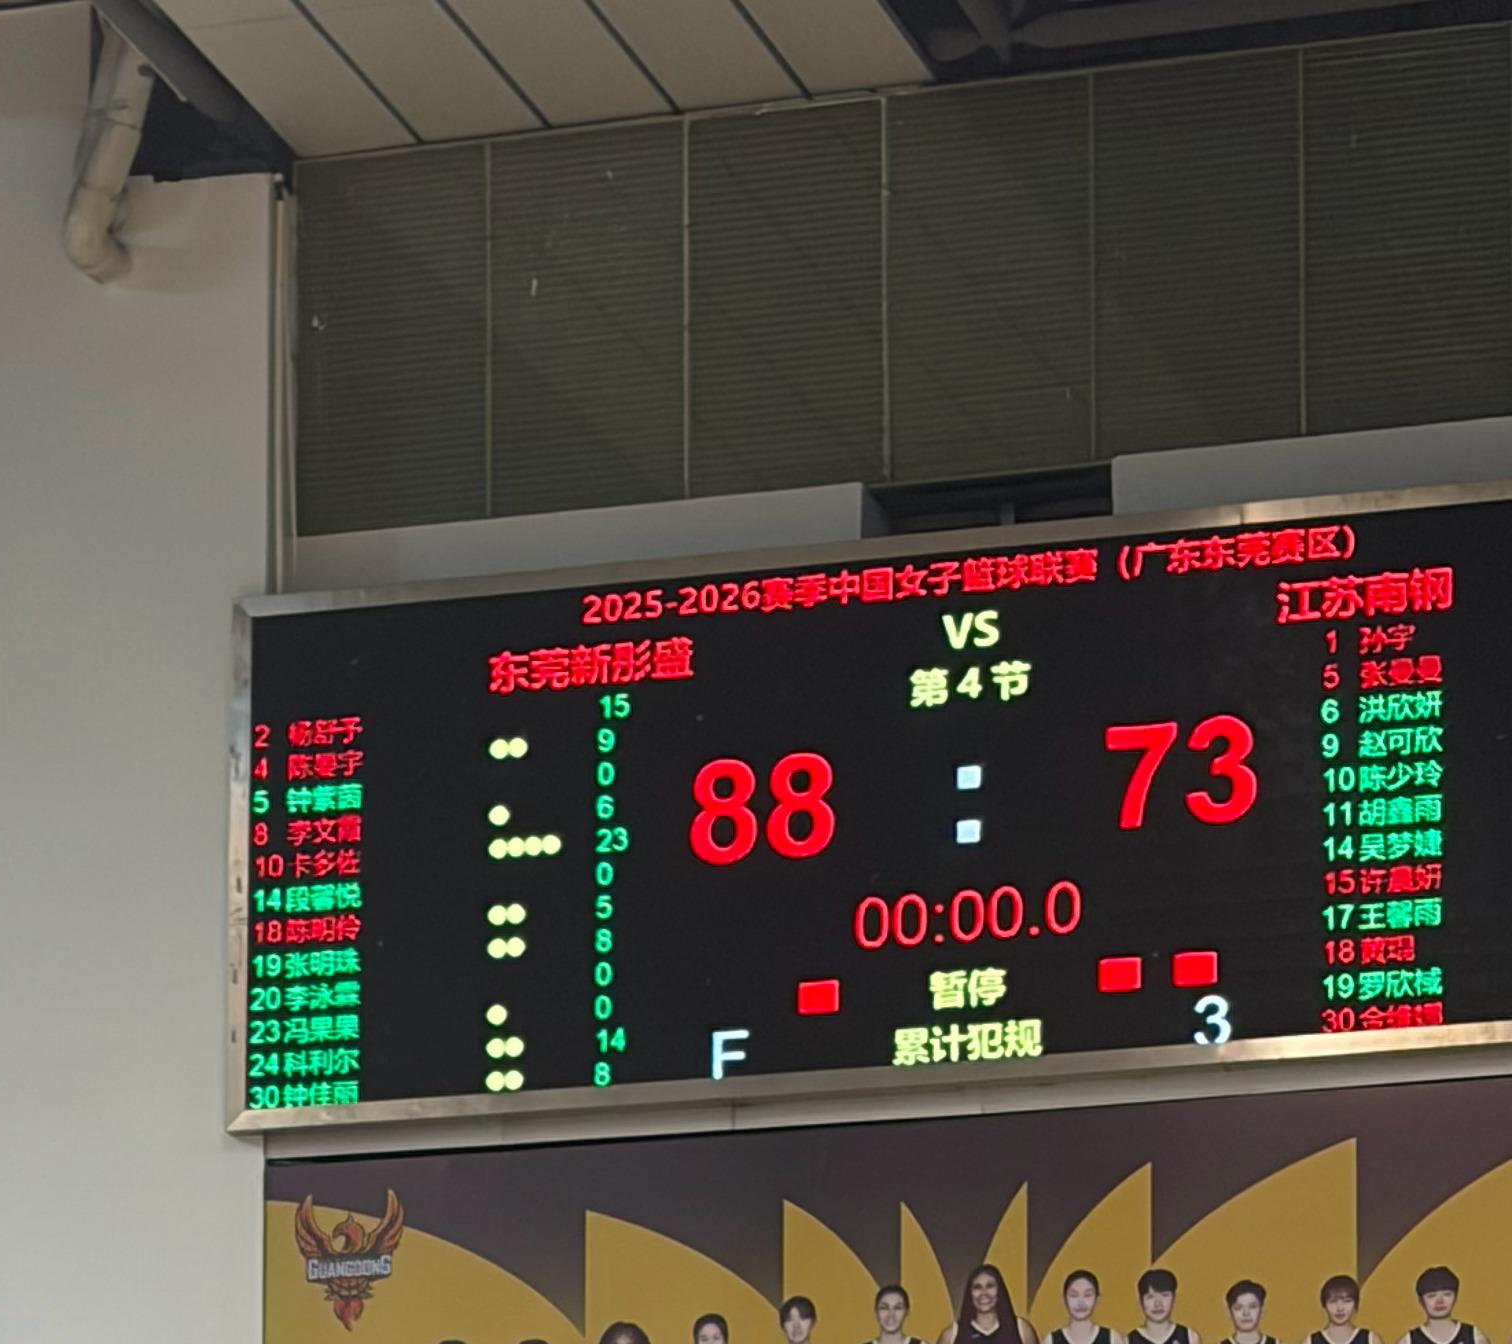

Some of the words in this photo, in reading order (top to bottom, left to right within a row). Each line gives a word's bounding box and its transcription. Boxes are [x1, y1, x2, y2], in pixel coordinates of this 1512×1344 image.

[1277, 567, 1452, 623] 江苏南钢
[943, 610, 999, 649] VS
[1327, 631, 1336, 652] 1
[489, 637, 693, 694] 东莞新彤盛
[1324, 665, 1339, 688] 5
[255, 725, 269, 747] 2
[601, 694, 629, 718] 15
[1321, 699, 1339, 723] 6
[1360, 691, 1442, 723] 洪欣妍
[254, 758, 267, 778] 4
[598, 729, 614, 752] 9
[1322, 734, 1339, 757] 9
[1359, 726, 1443, 757] 赵可欣
[254, 790, 269, 813] 5
[598, 762, 614, 785] 0
[1106, 716, 1257, 828] 73
[1324, 767, 1355, 792] 10
[1359, 760, 1442, 792] 陈少玲
[254, 823, 267, 845] 8
[597, 795, 613, 818] 6
[690, 753, 834, 864] 88
[1324, 802, 1351, 826] 11
[256, 855, 283, 876] 10
[596, 827, 628, 852] 23
[1324, 836, 1354, 861] 14
[254, 888, 281, 911] 14
[597, 862, 613, 885] 0
[1326, 870, 1355, 893] 15
[255, 921, 282, 942] 18
[597, 895, 612, 918] 5
[855, 881, 1080, 948] 00:00.0
[1323, 904, 1354, 930] 17
[253, 954, 281, 977] 19
[596, 929, 611, 952] 8
[1326, 940, 1354, 963] 18
[251, 987, 281, 1011] 20
[596, 962, 612, 986] 0
[930, 968, 1006, 1010] 暂停
[1324, 974, 1354, 999] 19
[249, 1020, 280, 1044] 23
[596, 995, 611, 1019] 0
[893, 1019, 1042, 1066] 累计犯规
[1193, 995, 1232, 1047] 3
[249, 1053, 279, 1077] 24
[284, 1048, 359, 1076] 科利尔
[597, 1028, 625, 1052] 14
[248, 1085, 280, 1110] 30
[595, 1062, 610, 1086] 8
